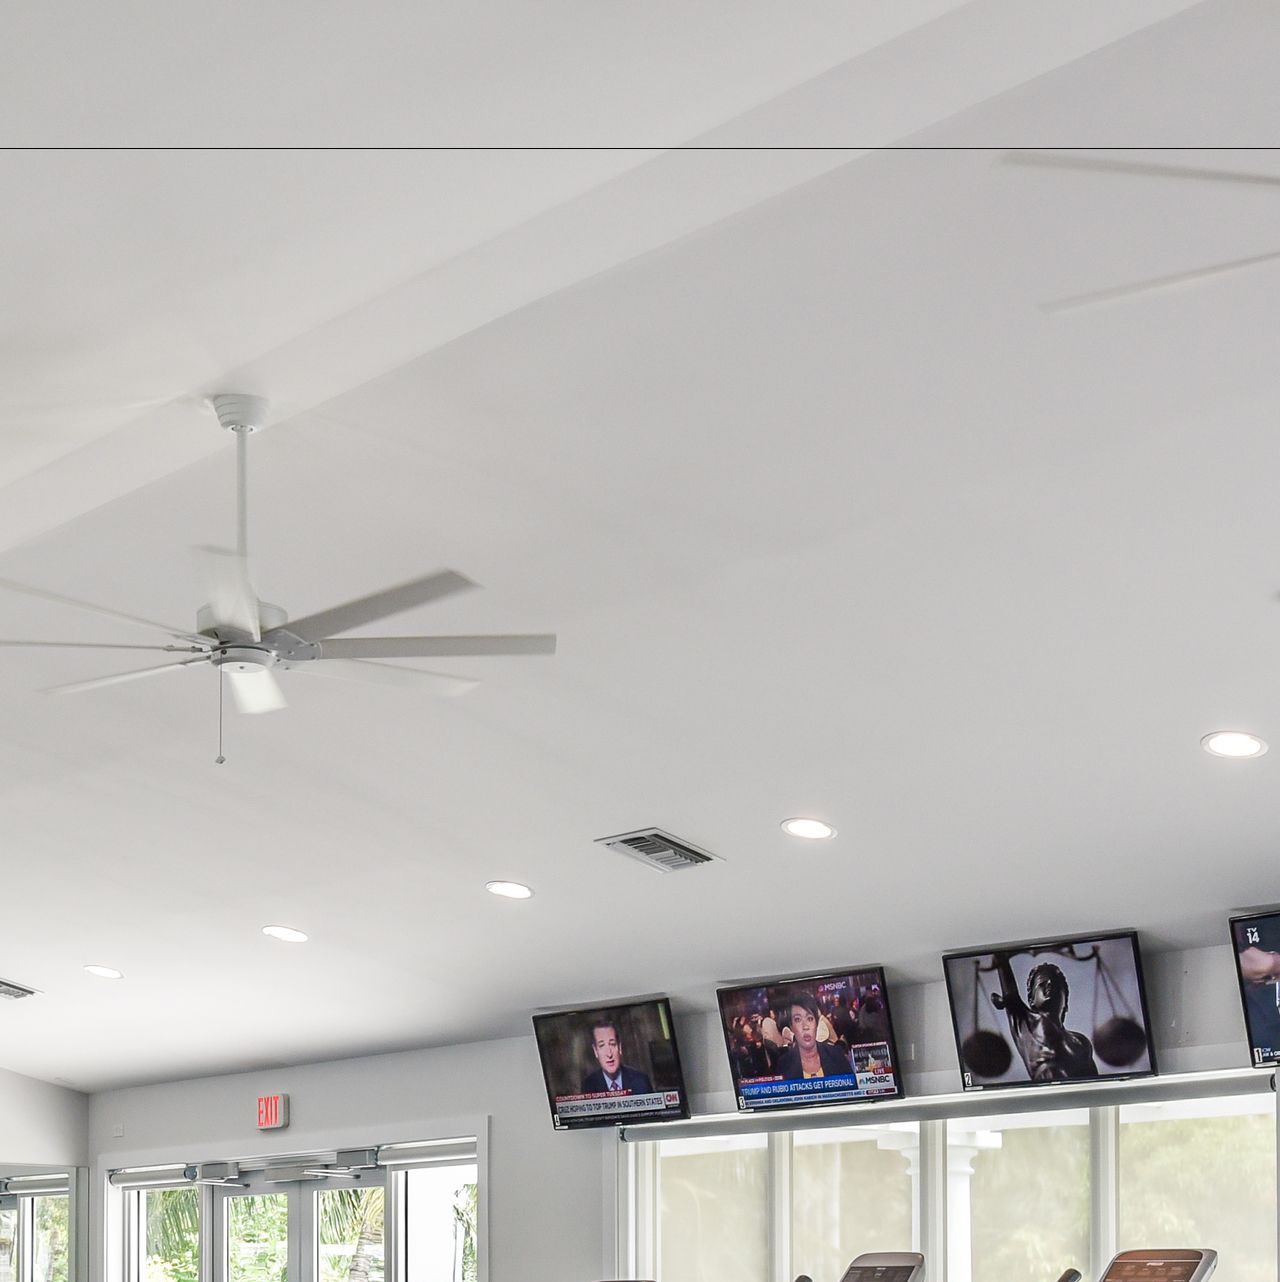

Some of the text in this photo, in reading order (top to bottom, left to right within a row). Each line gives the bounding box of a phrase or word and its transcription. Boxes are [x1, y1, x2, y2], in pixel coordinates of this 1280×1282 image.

[1247, 932, 1260, 944] 14
[824, 981, 847, 991] MSNBC
[865, 1075, 890, 1084] MSNBC
[741, 1078, 854, 1096] TRUMP AND RUBIO ATTACKS GET PERSONAL
[258, 1095, 280, 1127] EXIT
